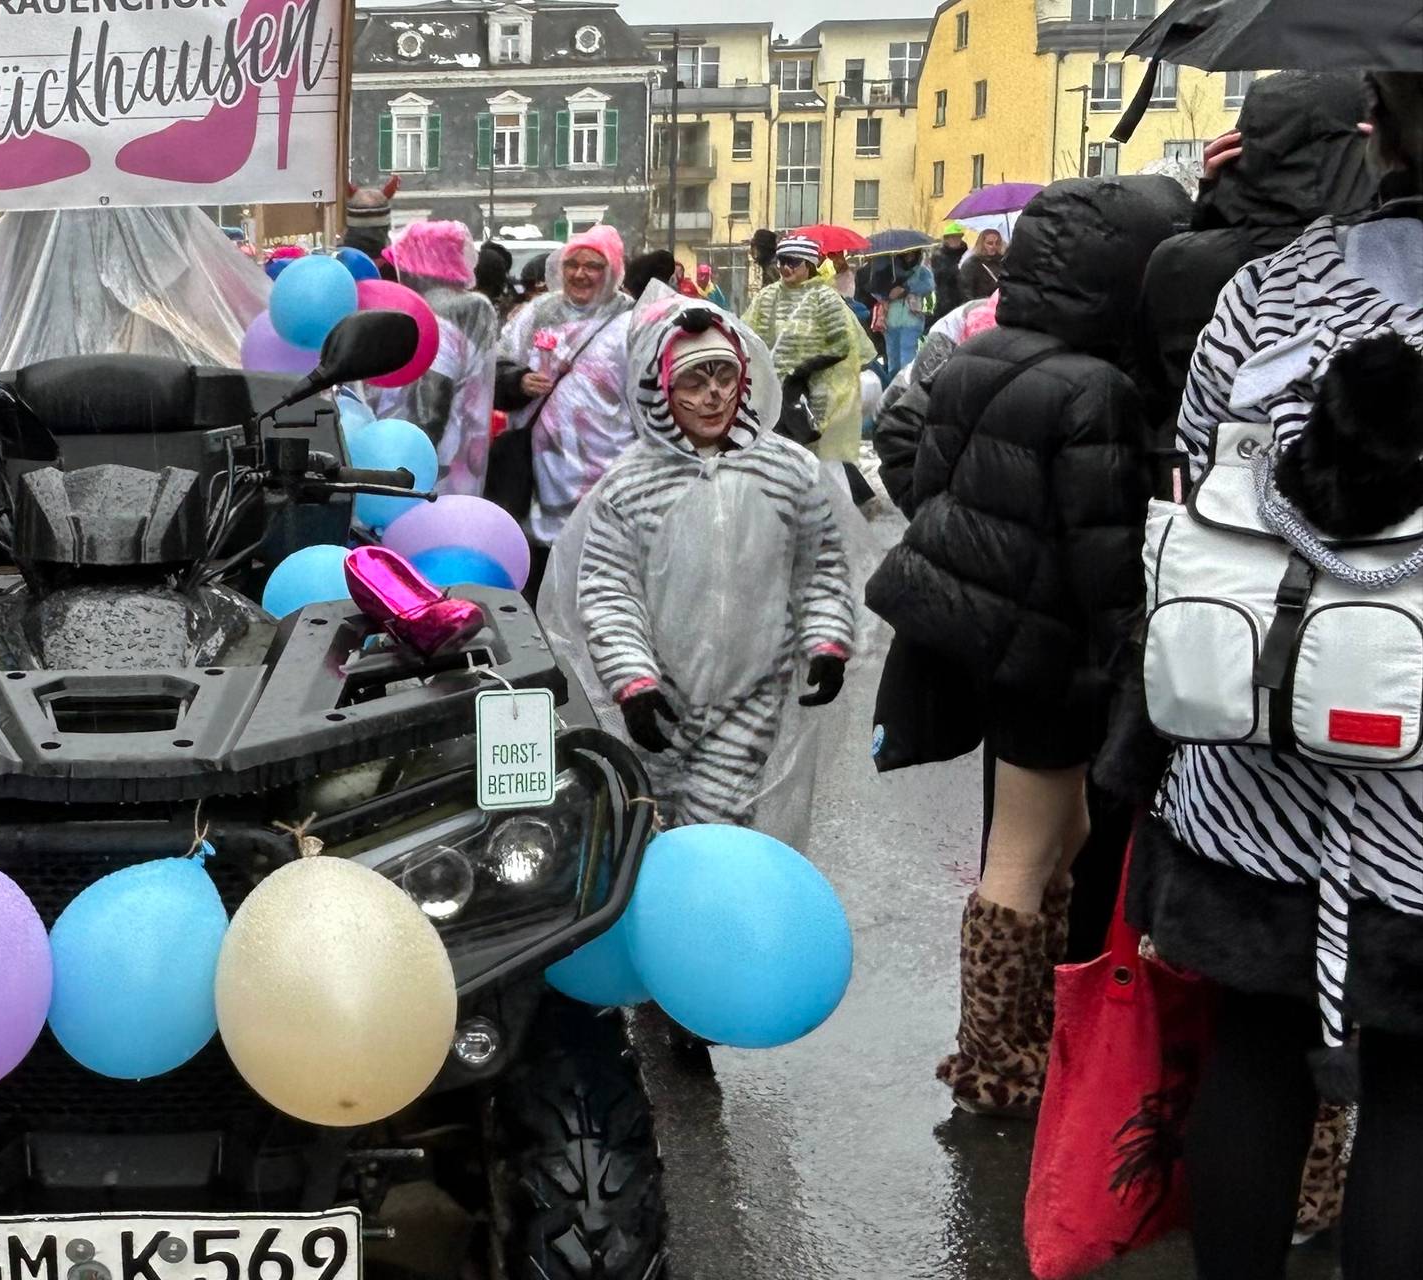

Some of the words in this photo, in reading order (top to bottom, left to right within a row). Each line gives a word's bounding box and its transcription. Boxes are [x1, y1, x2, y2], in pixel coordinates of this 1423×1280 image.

[492, 743, 542, 765] FORST-
[488, 772, 546, 795] BETRIEB
[121, 1230, 171, 1280] K
[193, 1226, 348, 1280] 569
